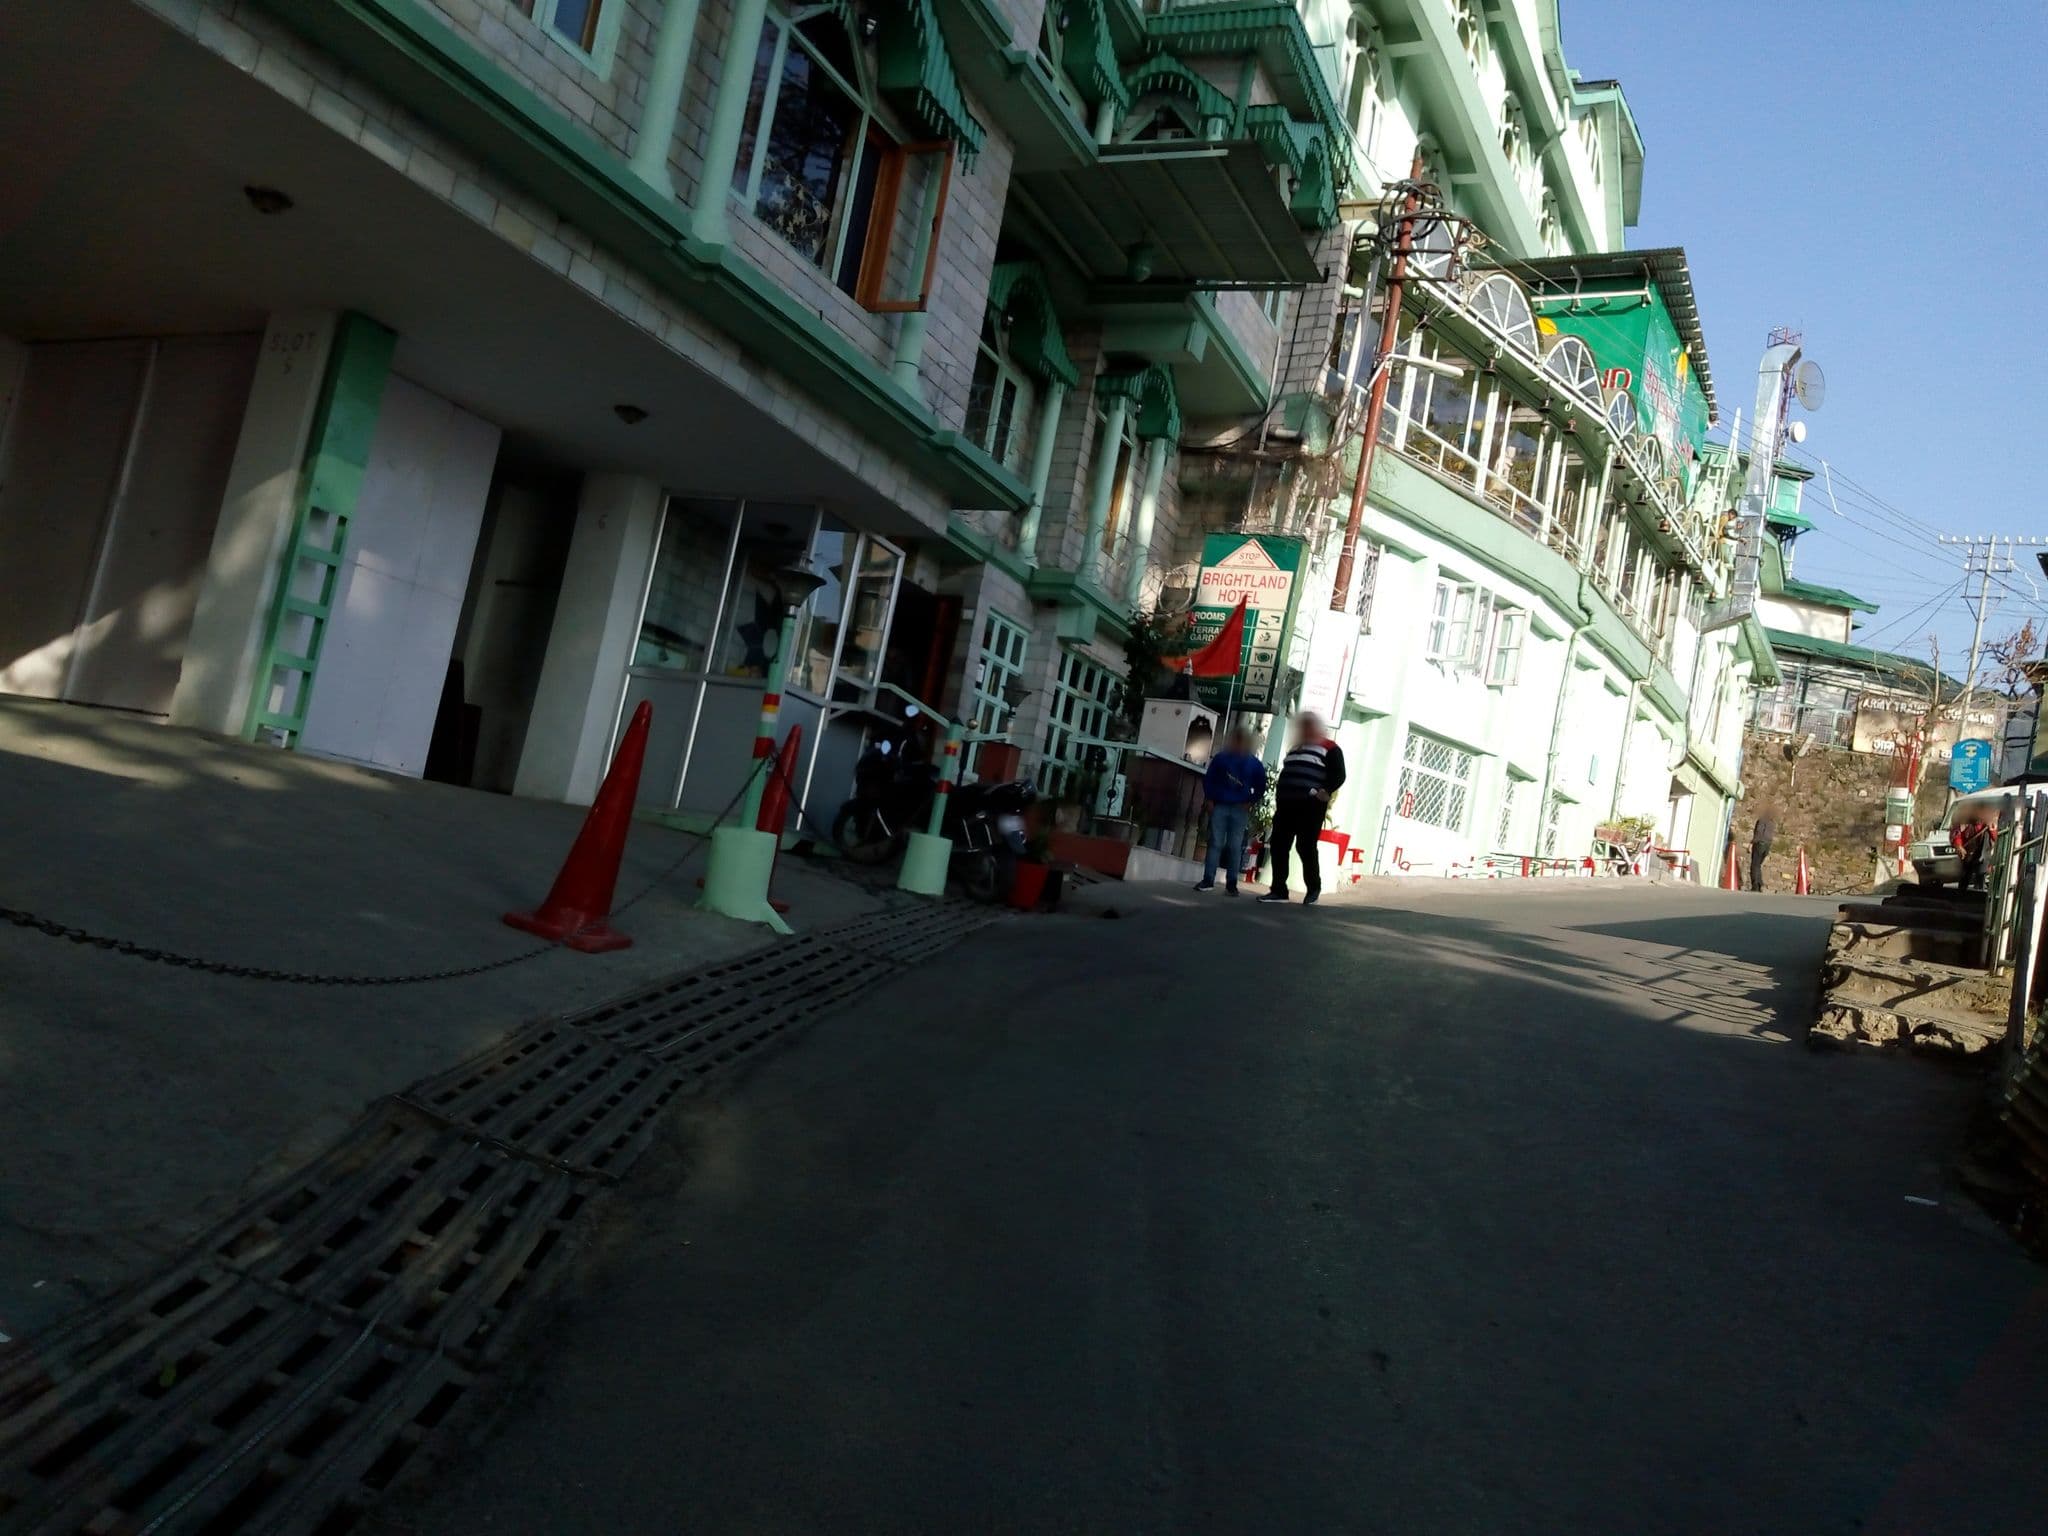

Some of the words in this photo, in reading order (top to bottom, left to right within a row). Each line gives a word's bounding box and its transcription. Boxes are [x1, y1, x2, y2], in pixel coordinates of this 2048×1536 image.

[1238, 551, 1261, 561] STOP
[1202, 572, 1288, 589] BRIGHTLAND
[1217, 589, 1260, 605] HOTEL
[1193, 611, 1226, 622] ROOMS
[1192, 625, 1222, 635] TERRA
[1189, 634, 1217, 643] GARD
[1862, 698, 1892, 711] ARMY
